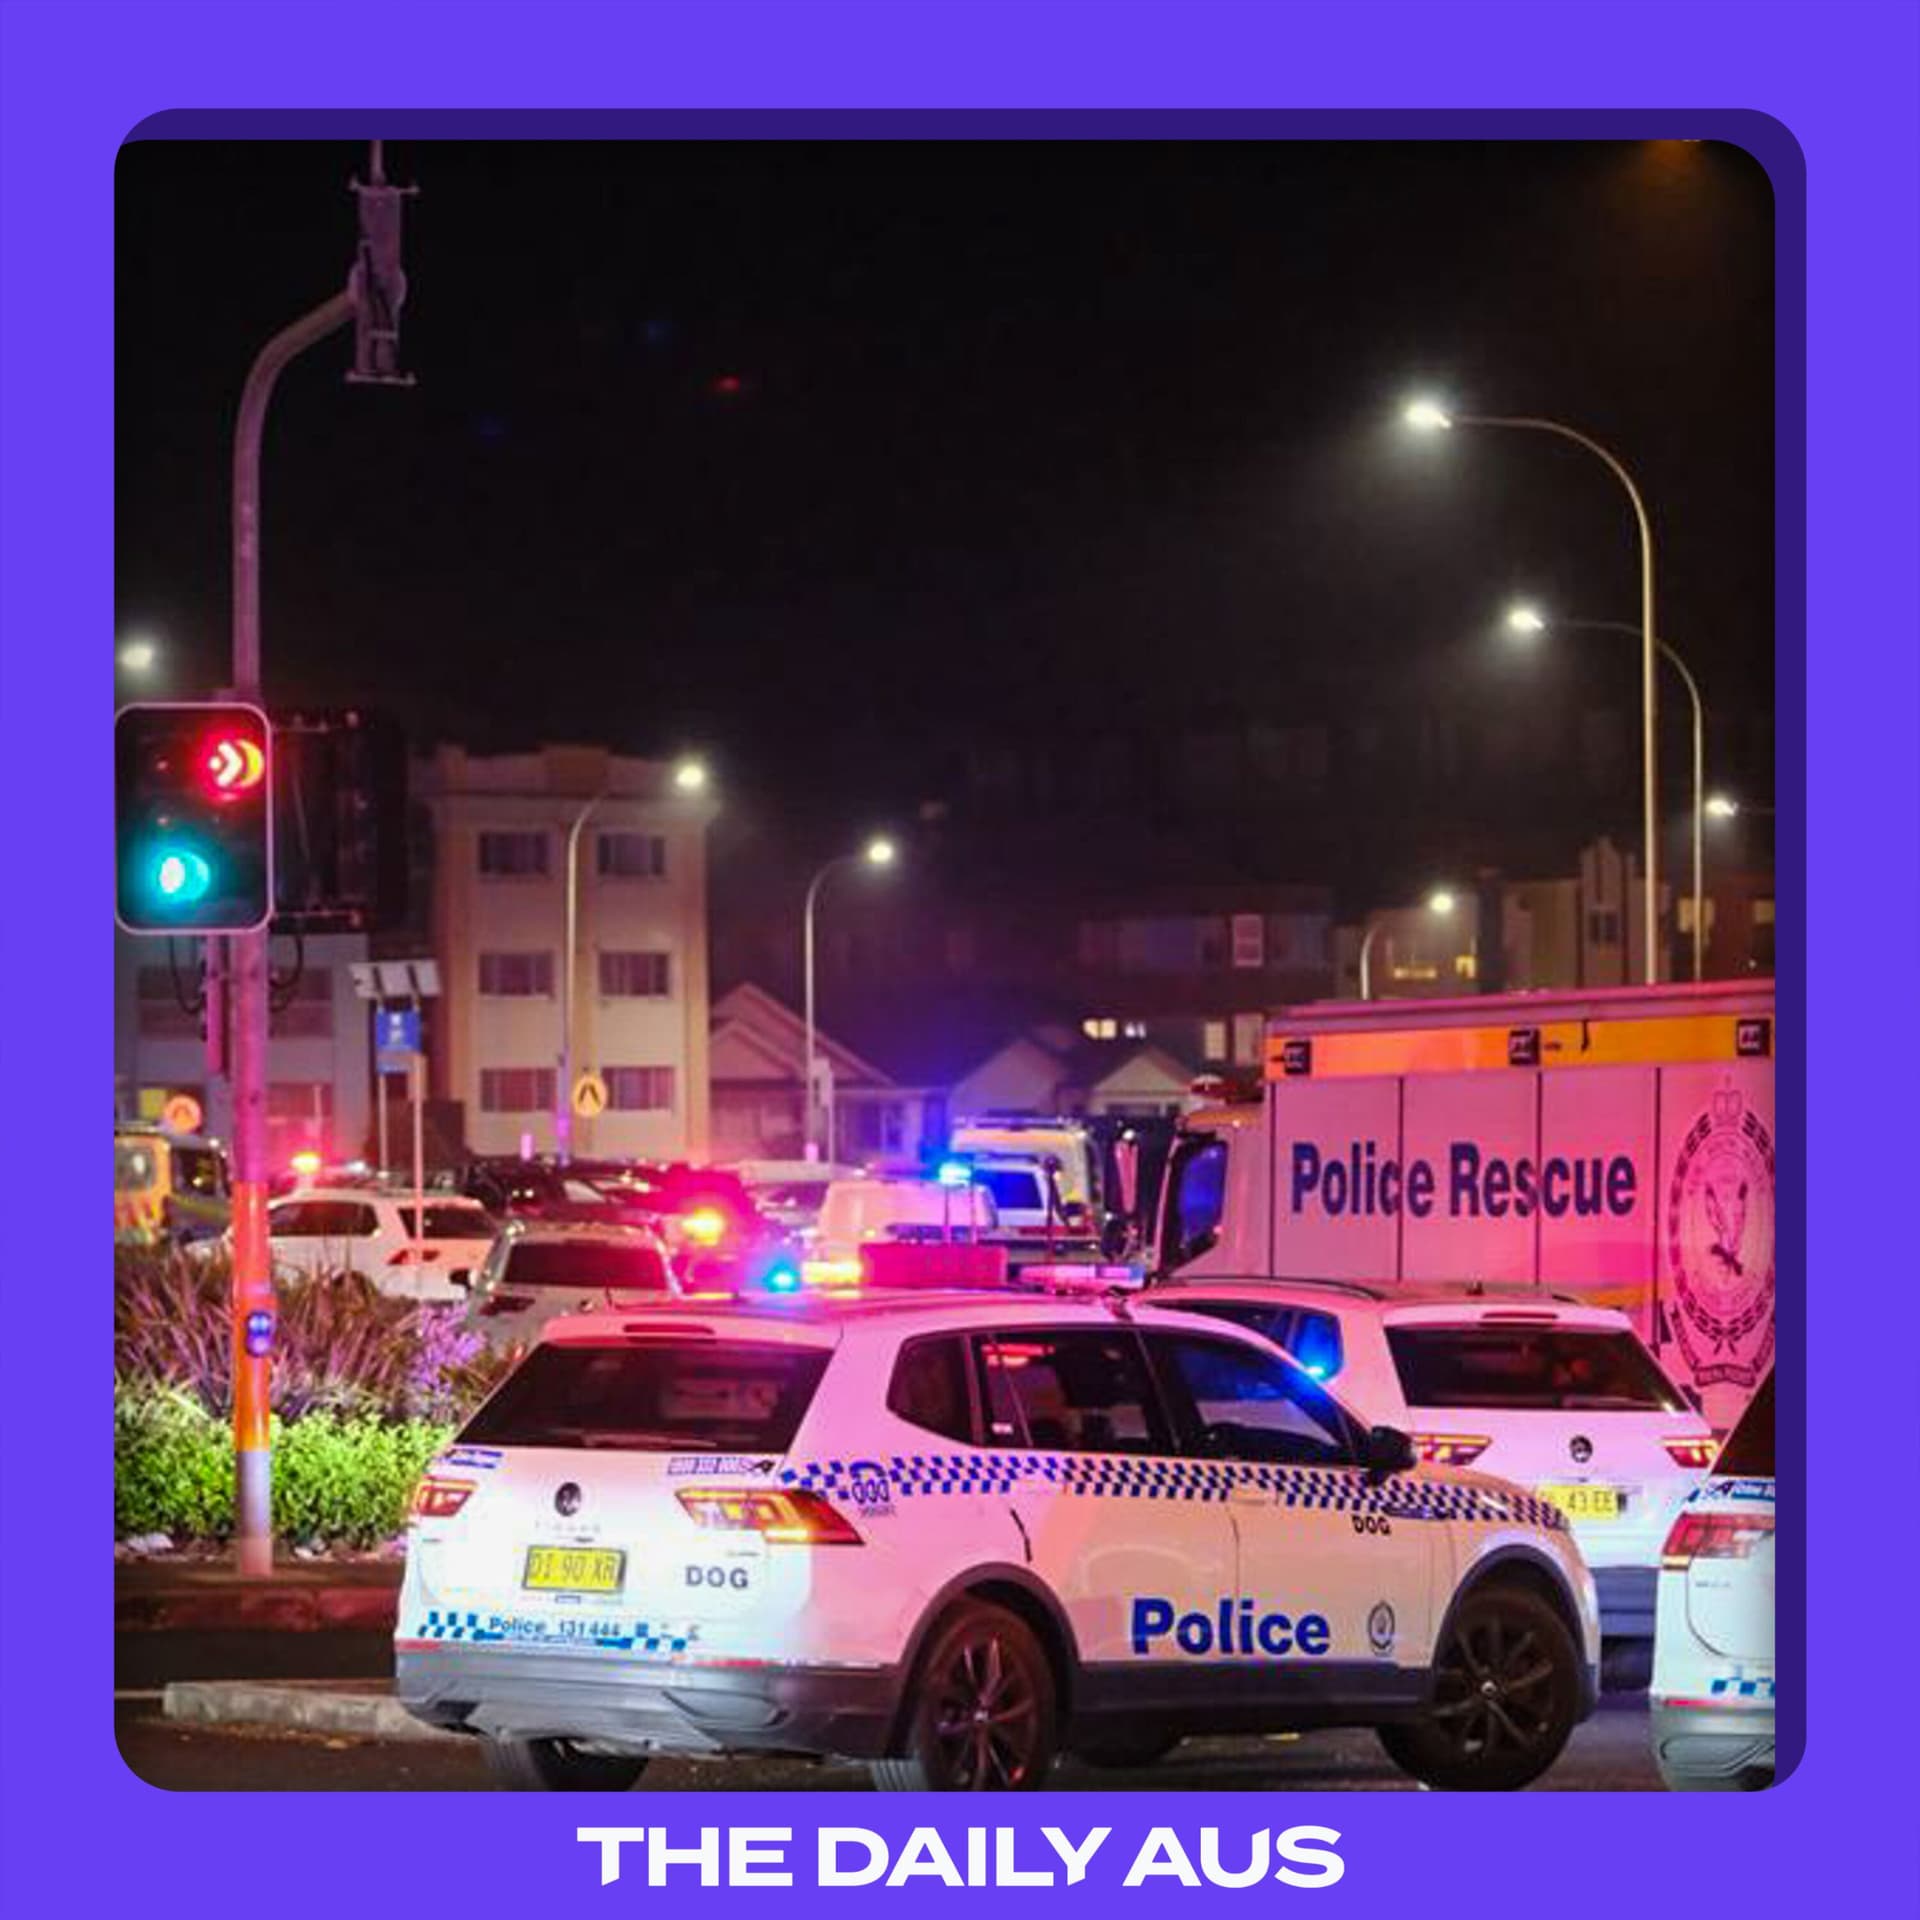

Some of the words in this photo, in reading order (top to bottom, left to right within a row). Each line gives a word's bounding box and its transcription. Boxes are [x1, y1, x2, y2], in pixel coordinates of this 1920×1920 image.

[1291, 1142, 1435, 1218] Police
[1449, 1141, 1638, 1219] Rescue
[685, 1564, 749, 1590] DOG
[489, 1616, 547, 1634] Police
[1131, 1597, 1331, 1656] Police
